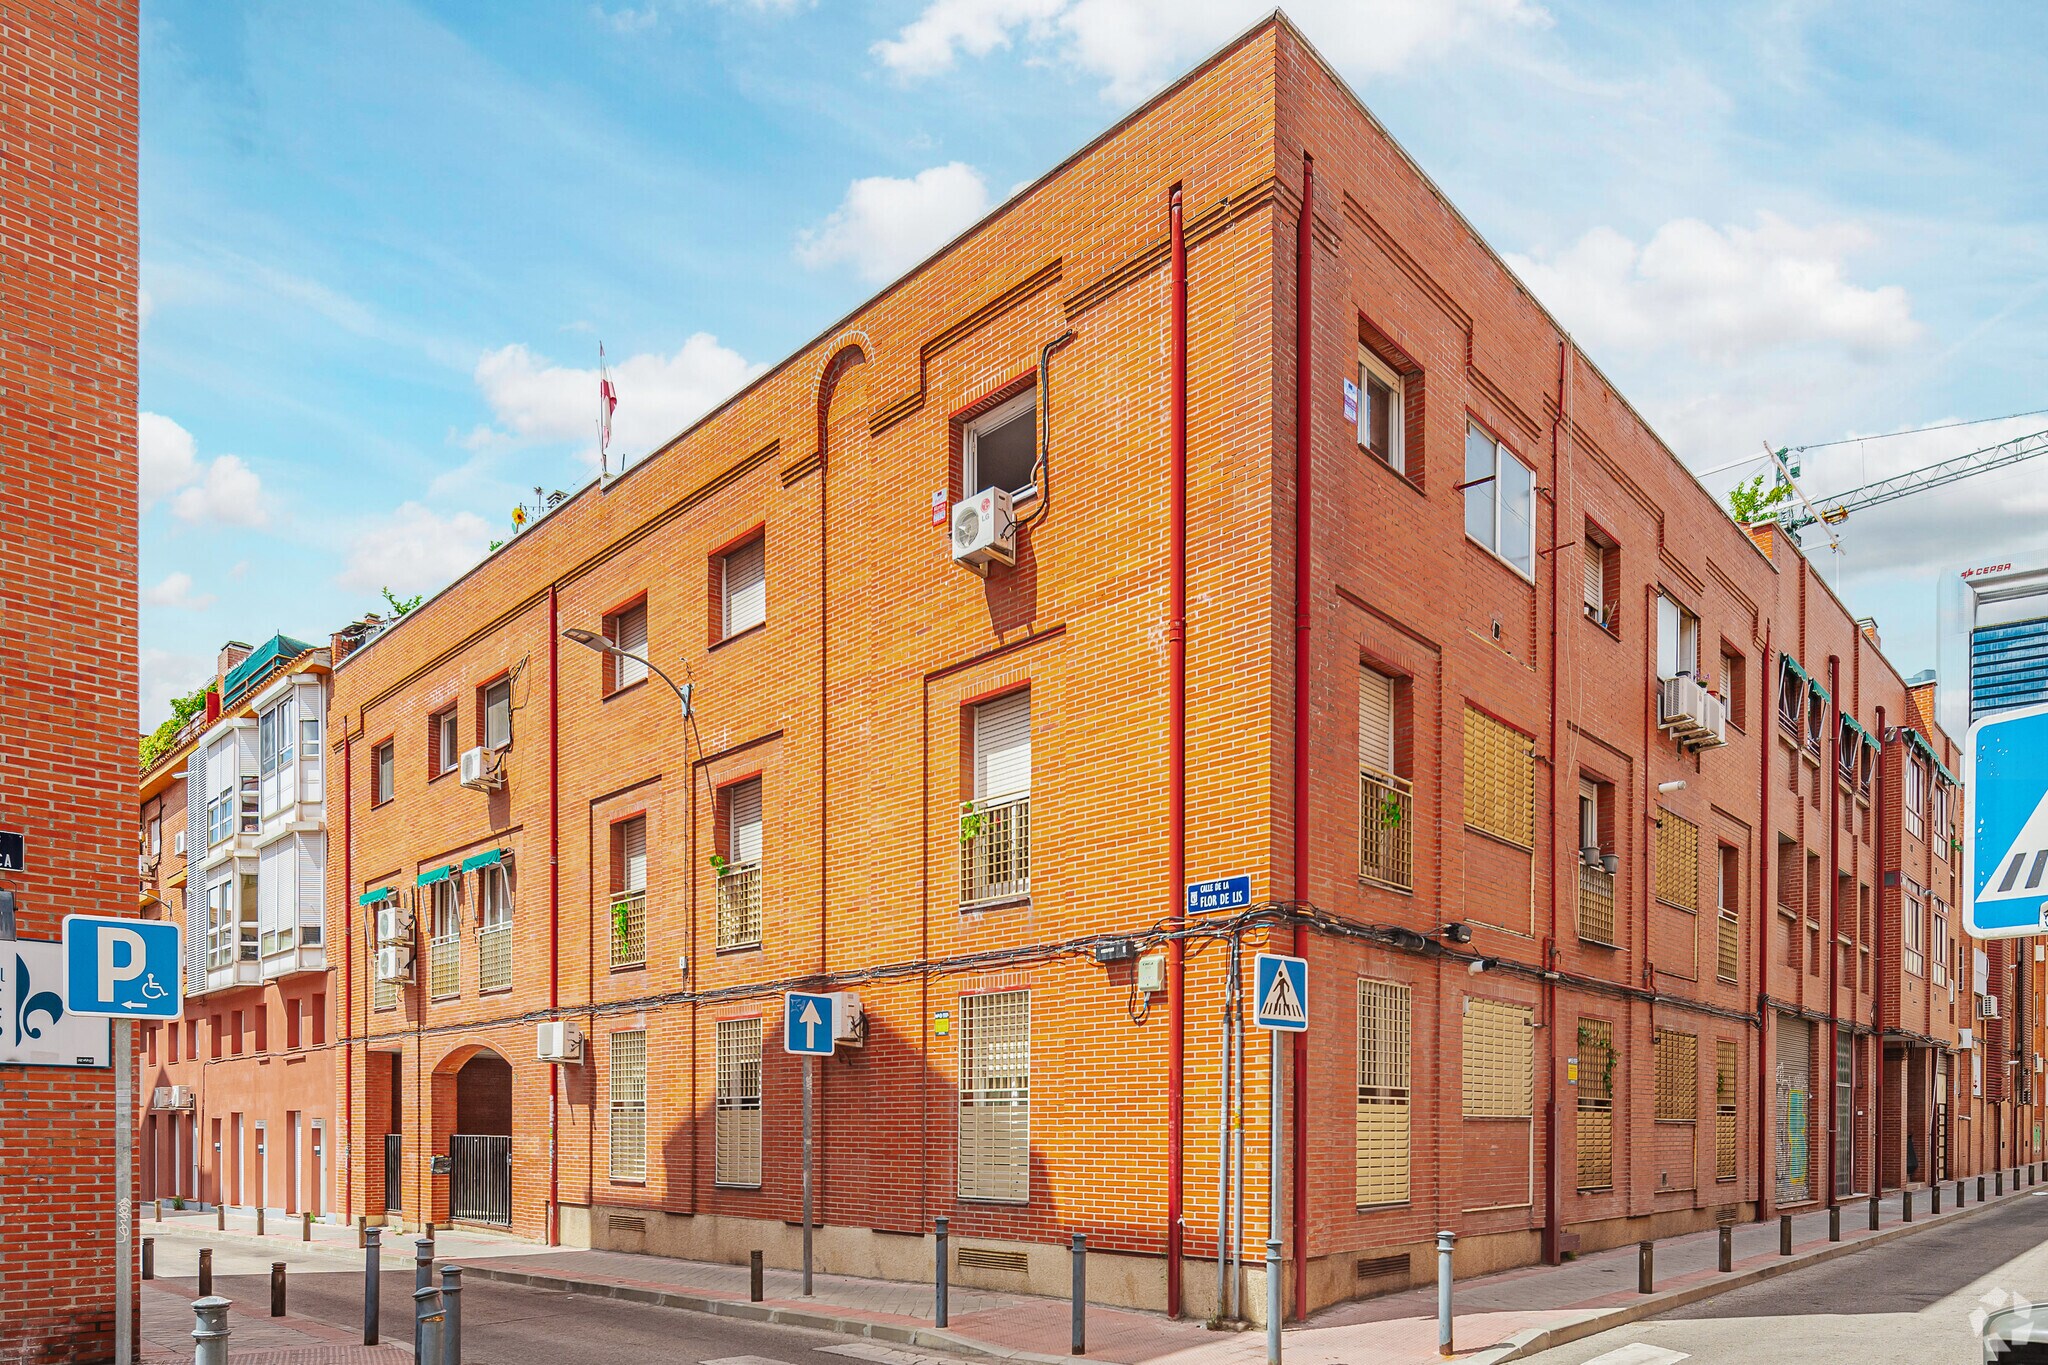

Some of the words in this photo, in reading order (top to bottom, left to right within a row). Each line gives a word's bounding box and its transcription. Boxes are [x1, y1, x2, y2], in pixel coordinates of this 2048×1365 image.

[981, 513, 990, 522] LG
[1976, 563, 2011, 575] CEPSA
[1200, 884, 1213, 893] CALLE
[1215, 882, 1221, 891] DE
[1223, 881, 1229, 890] LA
[1200, 895, 1217, 908] FLOR
[1220, 893, 1229, 905] DE
[1232, 891, 1242, 903] LIS
[97, 926, 147, 1003] P
